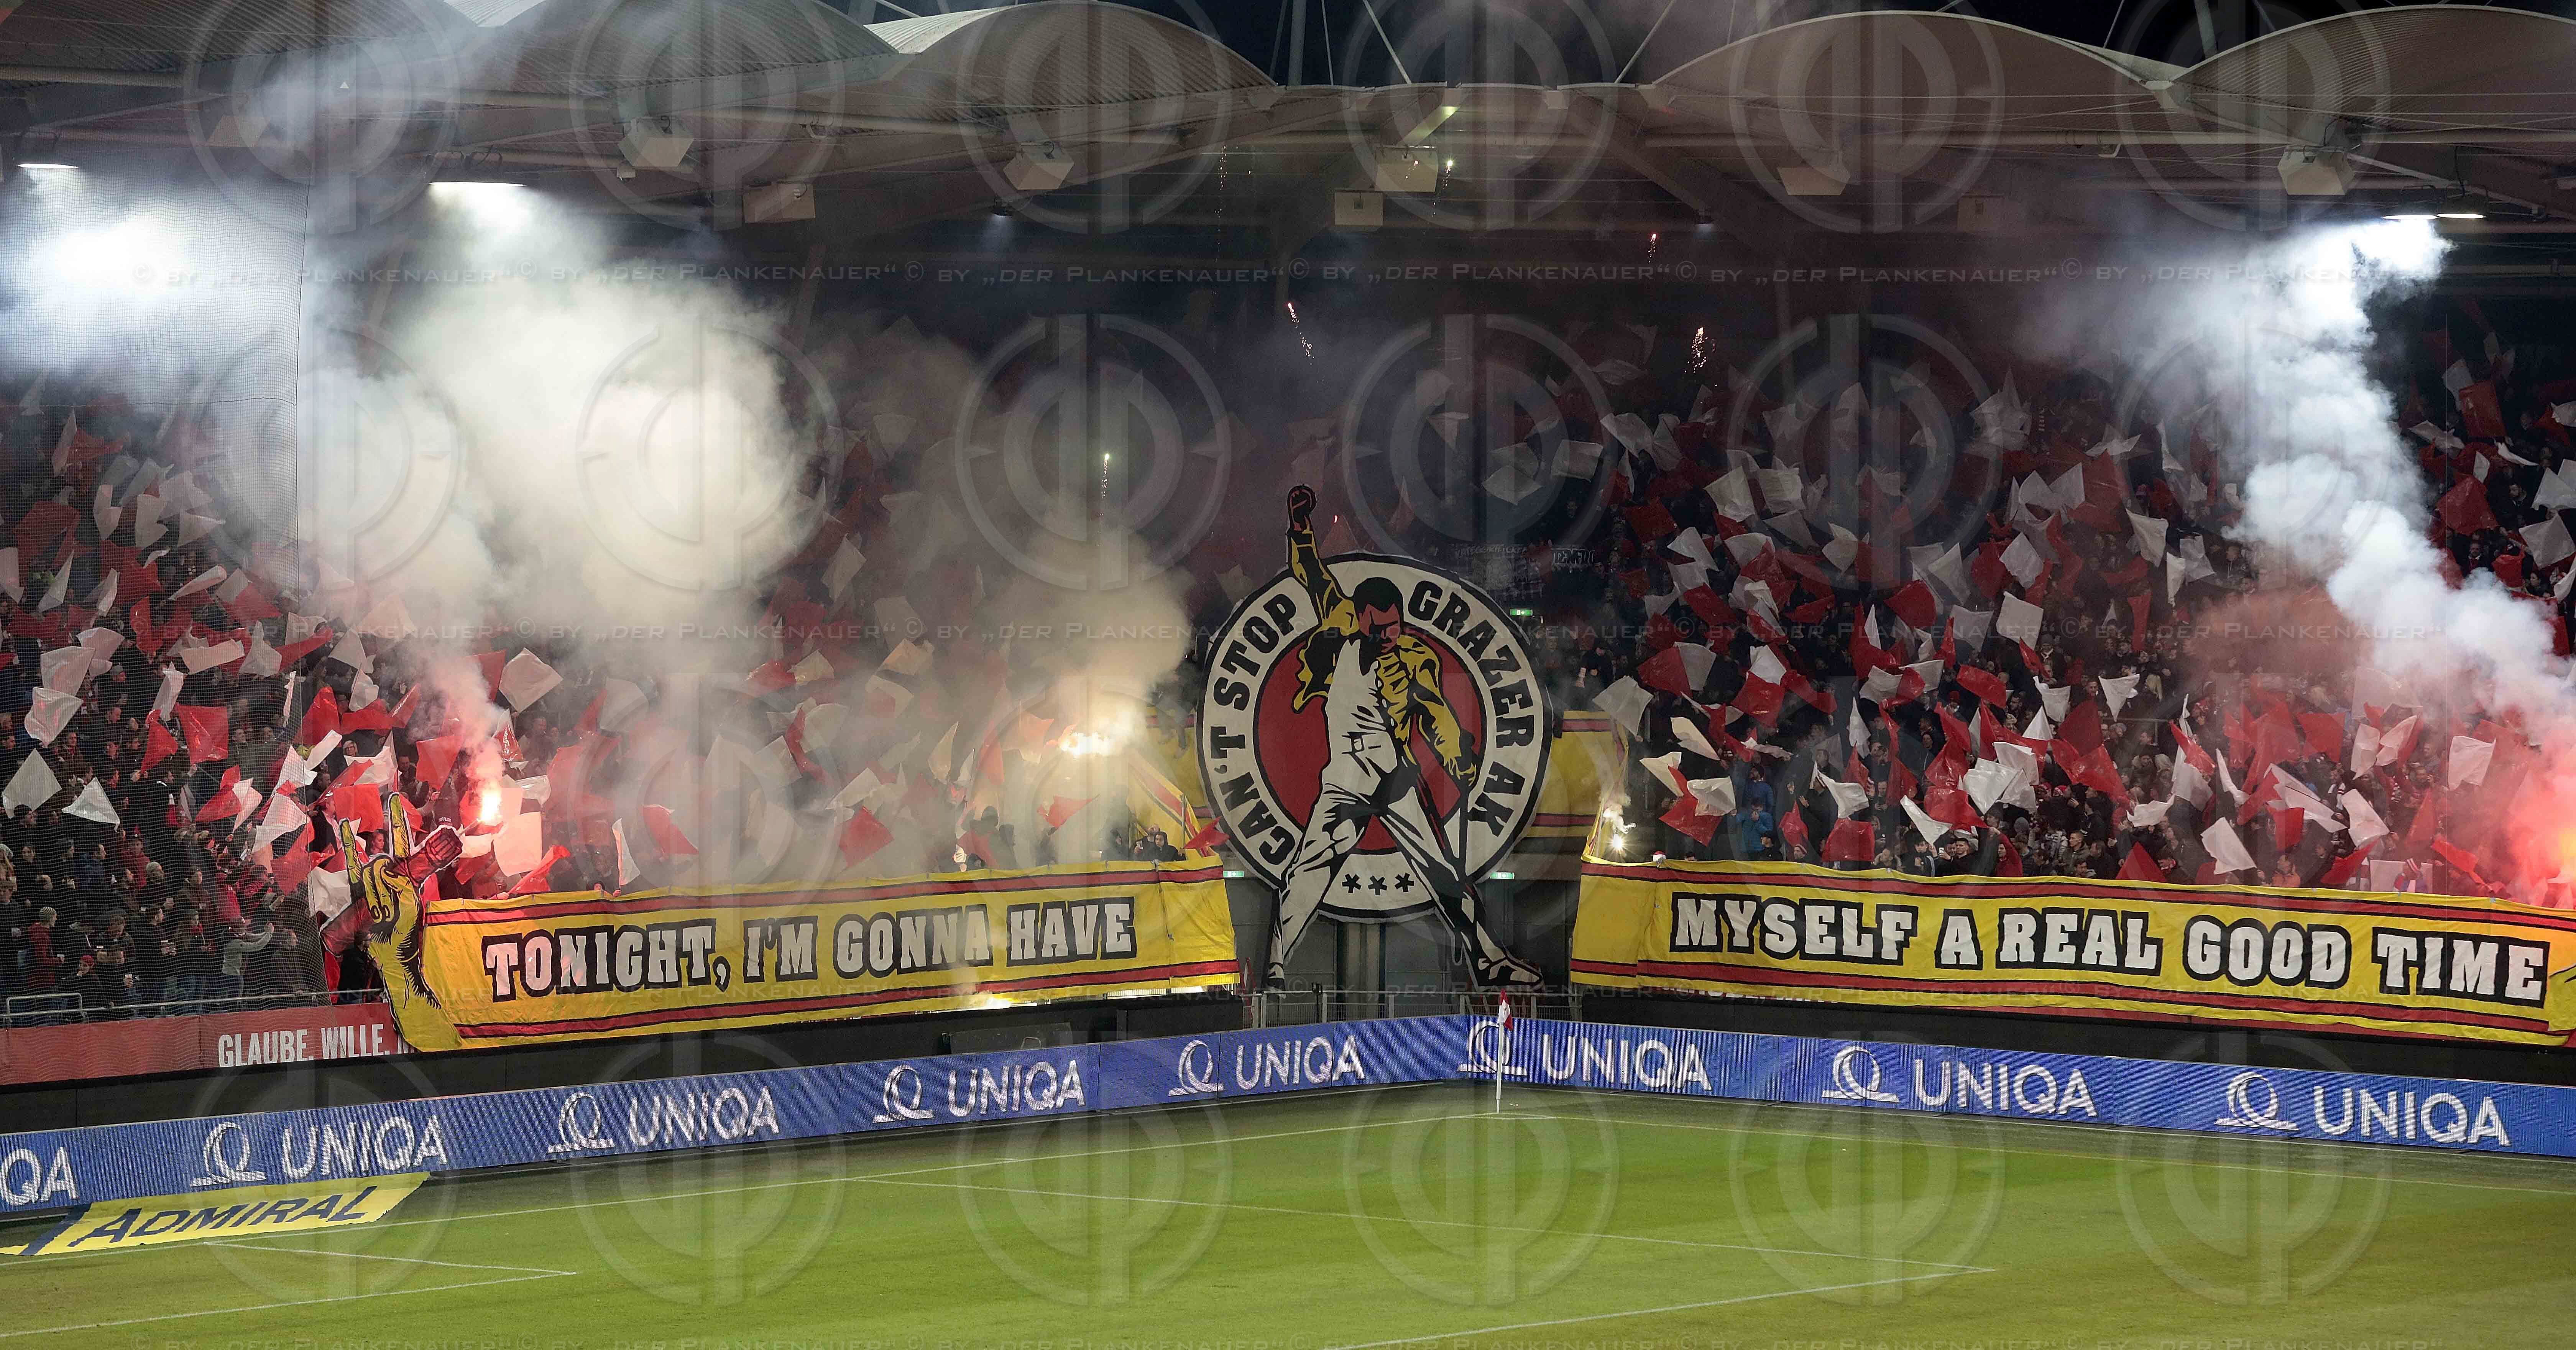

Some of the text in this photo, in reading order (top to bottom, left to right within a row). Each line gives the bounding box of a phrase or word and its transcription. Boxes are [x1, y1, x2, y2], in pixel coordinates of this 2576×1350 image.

[1408, 580, 1534, 748] GRAZER
[1211, 593, 1296, 865] CAN'T STOP
[1467, 761, 1526, 837] AK
[481, 896, 1137, 1002] TONIGHT, I'M GONNA HAVE
[1669, 892, 2551, 1009] MYSELF A REAL GOOD TIME
[218, 1030, 314, 1067] GLAUBE.
[321, 1024, 390, 1059] WILLE.
[1236, 1035, 1364, 1090] UNIQA
[1542, 1034, 1712, 1090] UNIQA
[629, 1086, 779, 1146] UNIQA
[948, 1060, 1085, 1117] UNIQA
[1916, 1060, 2098, 1116] UNIQA
[2314, 1085, 2511, 1146] UNIQA
[283, 1115, 449, 1179] UNIQA
[67, 1186, 377, 1247] ADMIRAL
